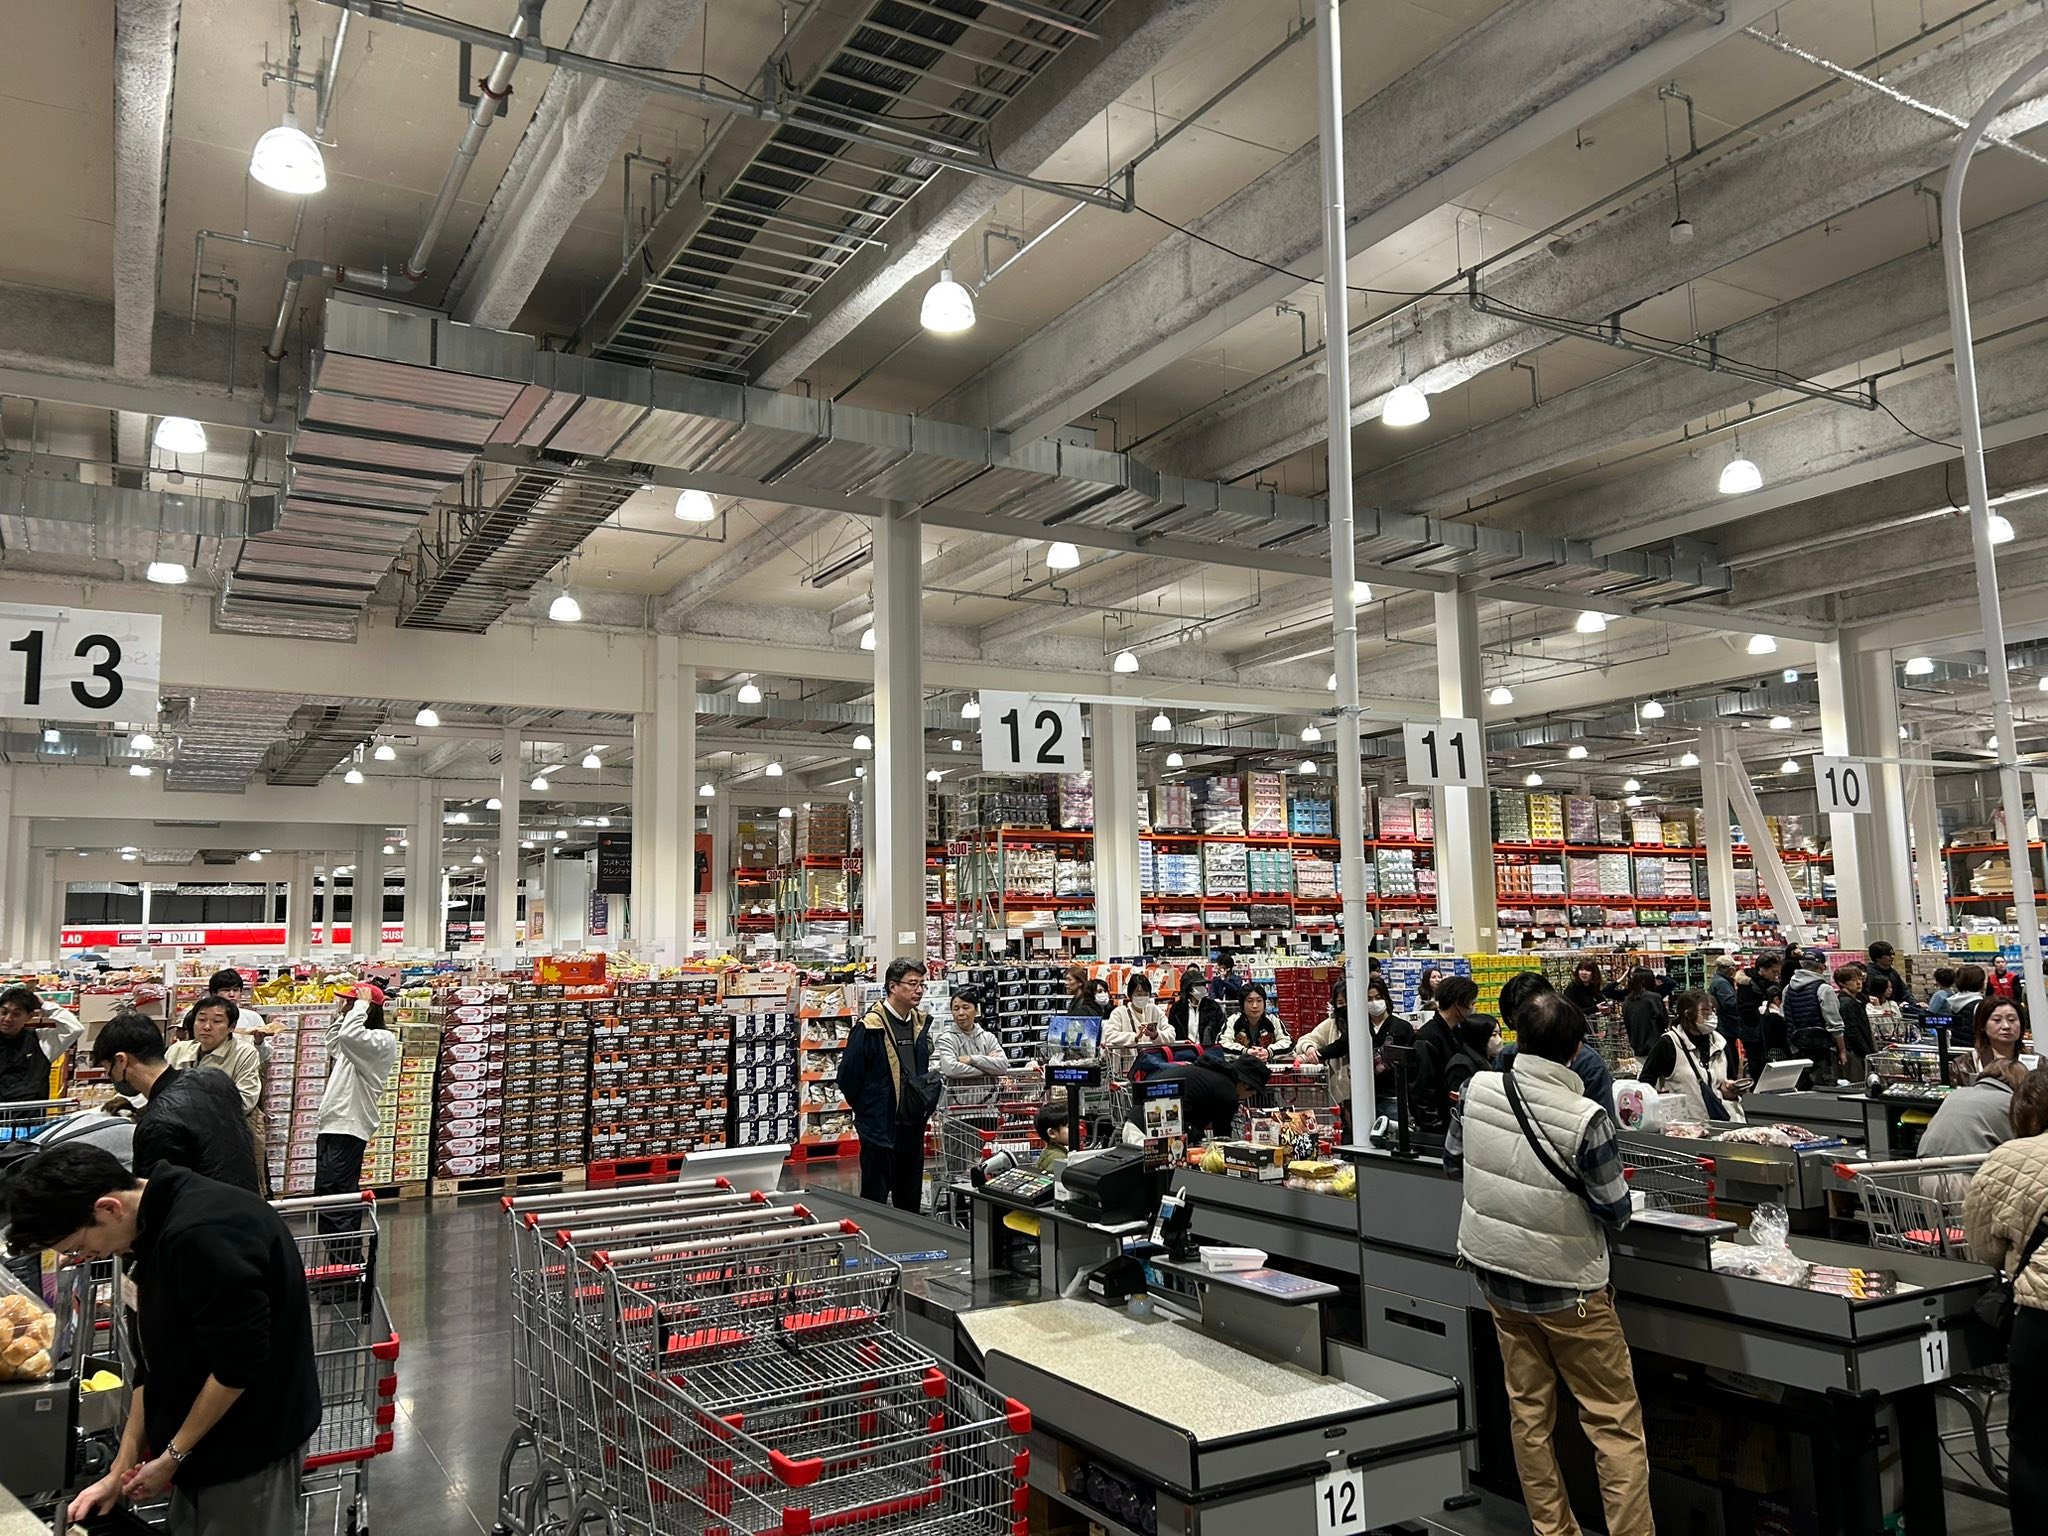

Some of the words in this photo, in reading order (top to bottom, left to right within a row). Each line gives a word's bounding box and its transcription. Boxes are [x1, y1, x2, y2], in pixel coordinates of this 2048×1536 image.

[10, 630, 124, 709] 13
[1000, 708, 1065, 764] 12
[1421, 730, 1466, 779] 11
[1825, 767, 1860, 807] 10
[843, 860, 859, 869] 302
[950, 843, 967, 855] 300
[767, 871, 783, 880] 304
[170, 933, 198, 943] DELI
[1926, 1339, 1944, 1373] 11
[1324, 1481, 1357, 1527] 12
